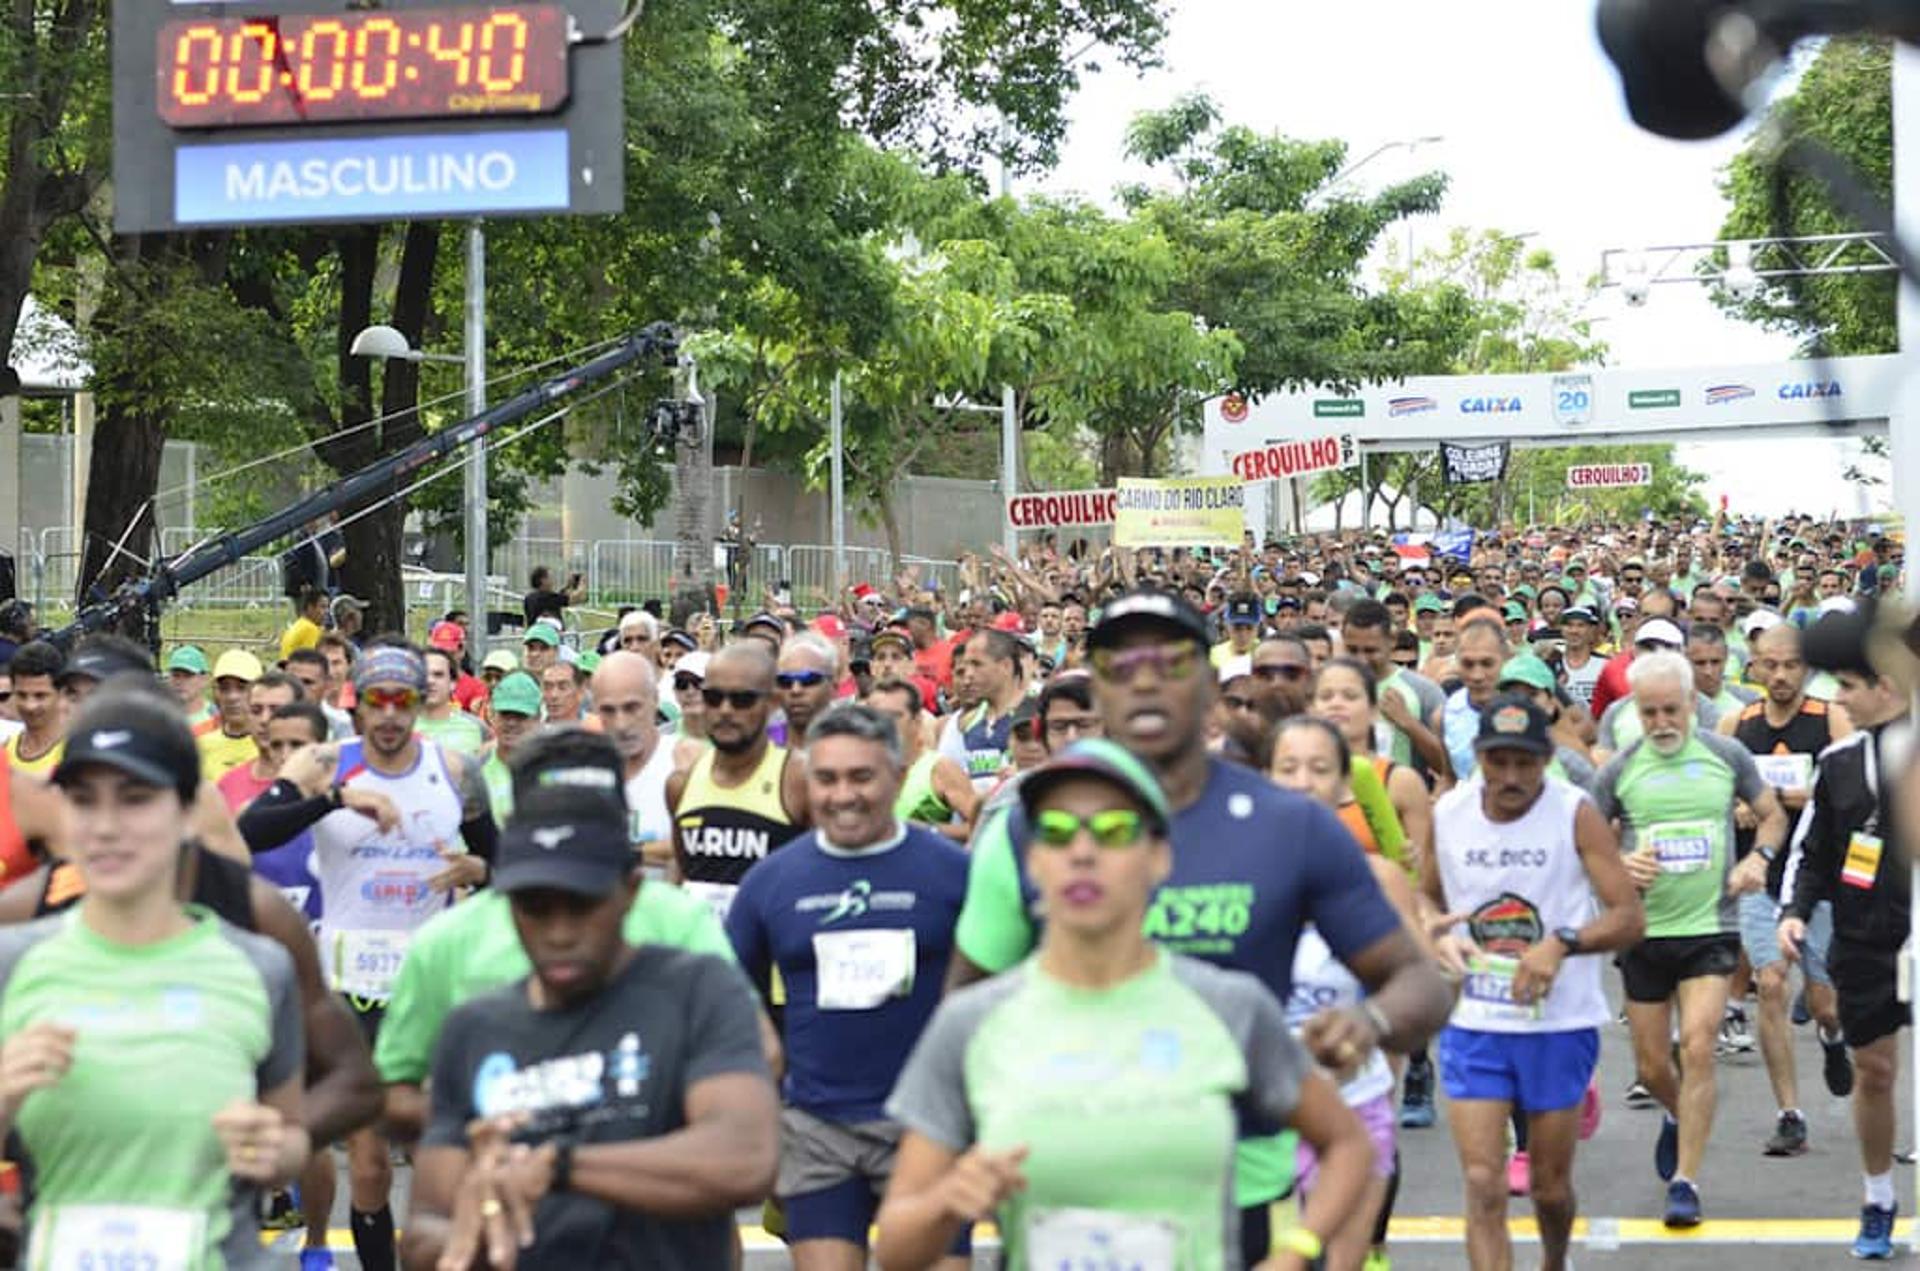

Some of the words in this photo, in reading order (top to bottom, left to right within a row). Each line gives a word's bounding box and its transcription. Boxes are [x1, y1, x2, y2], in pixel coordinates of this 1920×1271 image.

[173, 12, 528, 105] 00:00:40
[226, 152, 517, 201] MASCULINO
[1779, 381, 1842, 398] CAIXA
[1460, 397, 1522, 412] CAIXA
[1559, 391, 1588, 411] 20
[1232, 437, 1339, 481] CERQUILHO
[1572, 466, 1640, 484] CERQUILHO
[1117, 488, 1161, 510] CARMO
[1164, 488, 1181, 510] DO
[1184, 487, 1203, 509] RIO
[1205, 485, 1244, 508] CLARO
